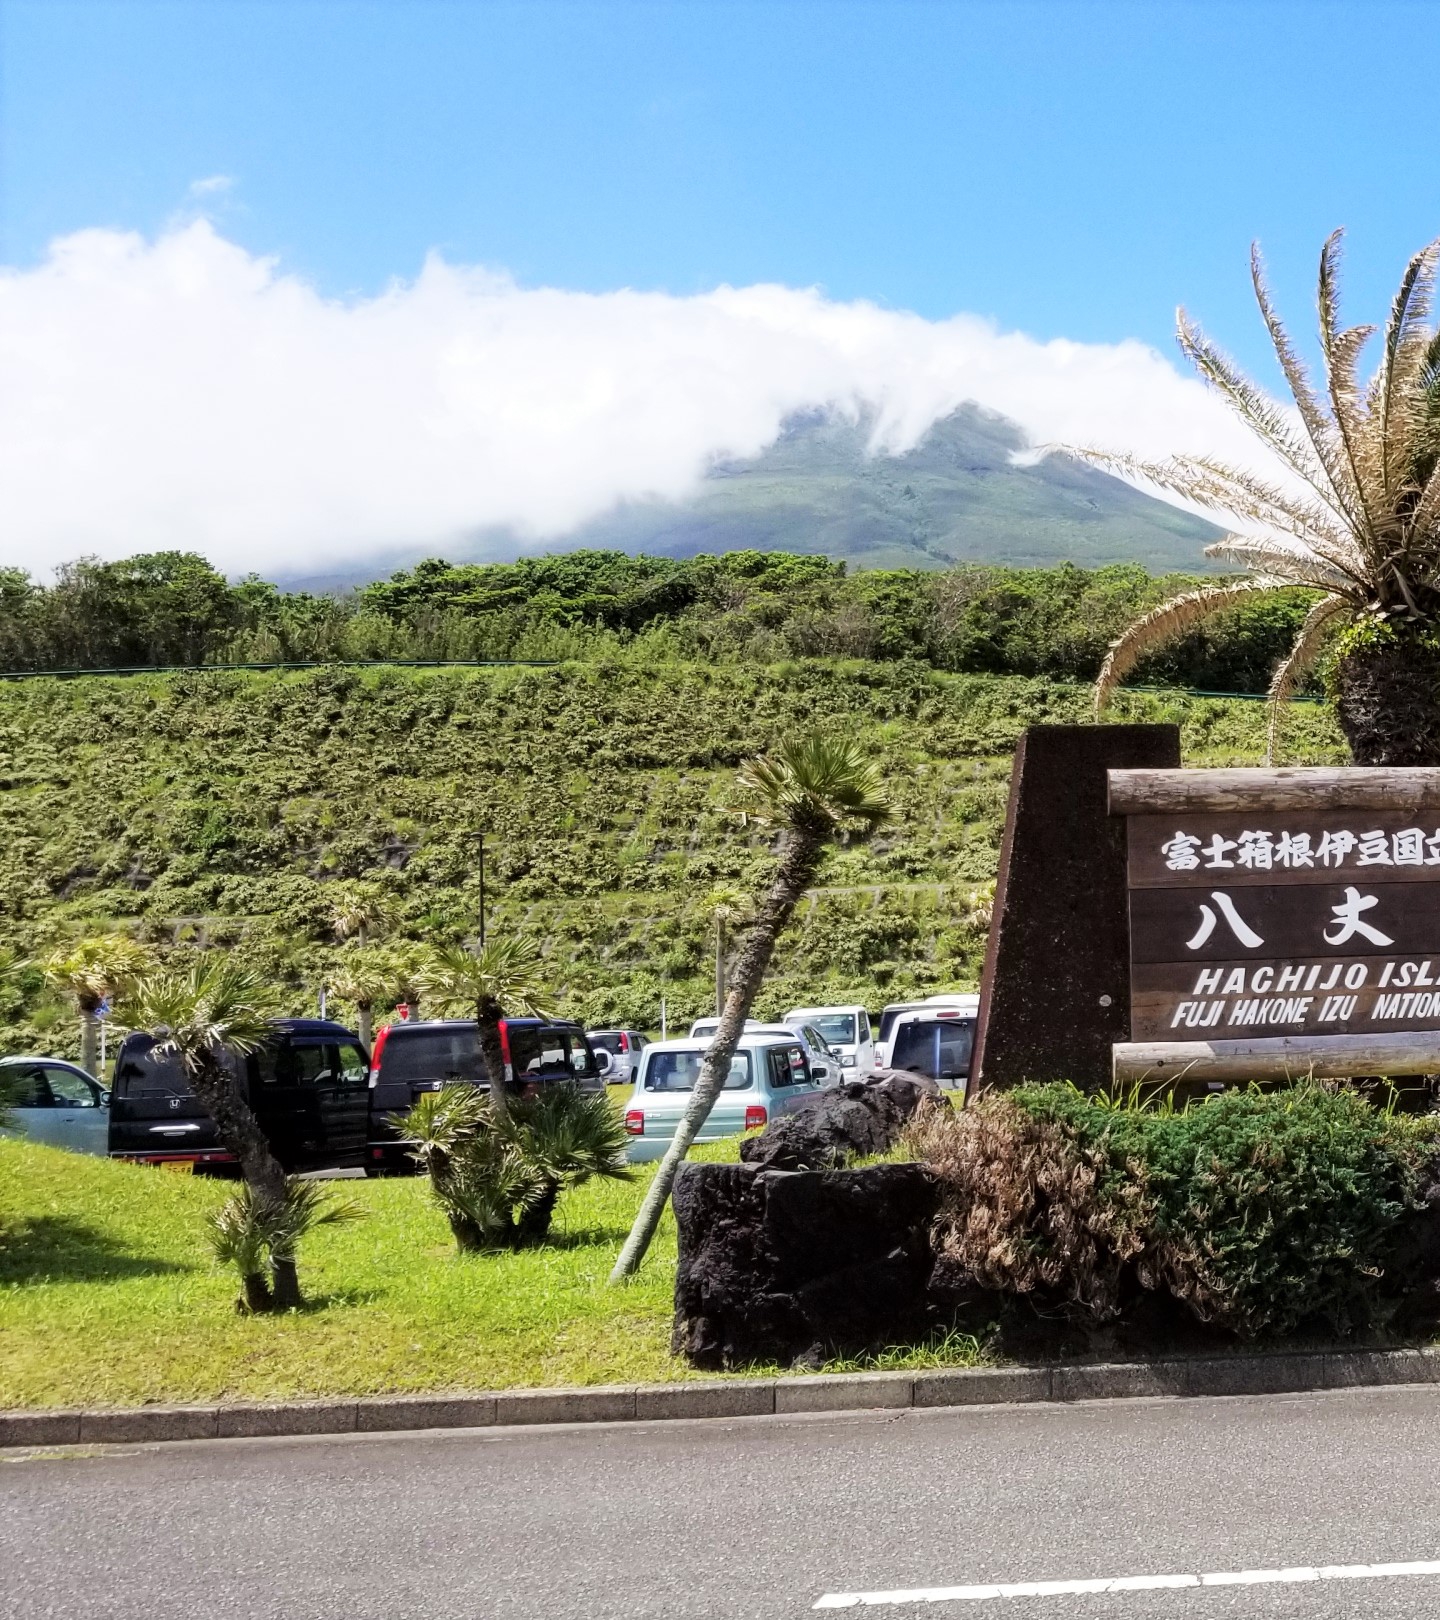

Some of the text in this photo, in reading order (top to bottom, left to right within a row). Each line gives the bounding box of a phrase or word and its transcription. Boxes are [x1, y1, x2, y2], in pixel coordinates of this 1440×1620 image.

[1192, 963, 1368, 995] HACHIJO
[1170, 1000, 1226, 1028] FUJI
[1228, 996, 1314, 1026] HAKONE
[1318, 995, 1358, 1022] IZU
